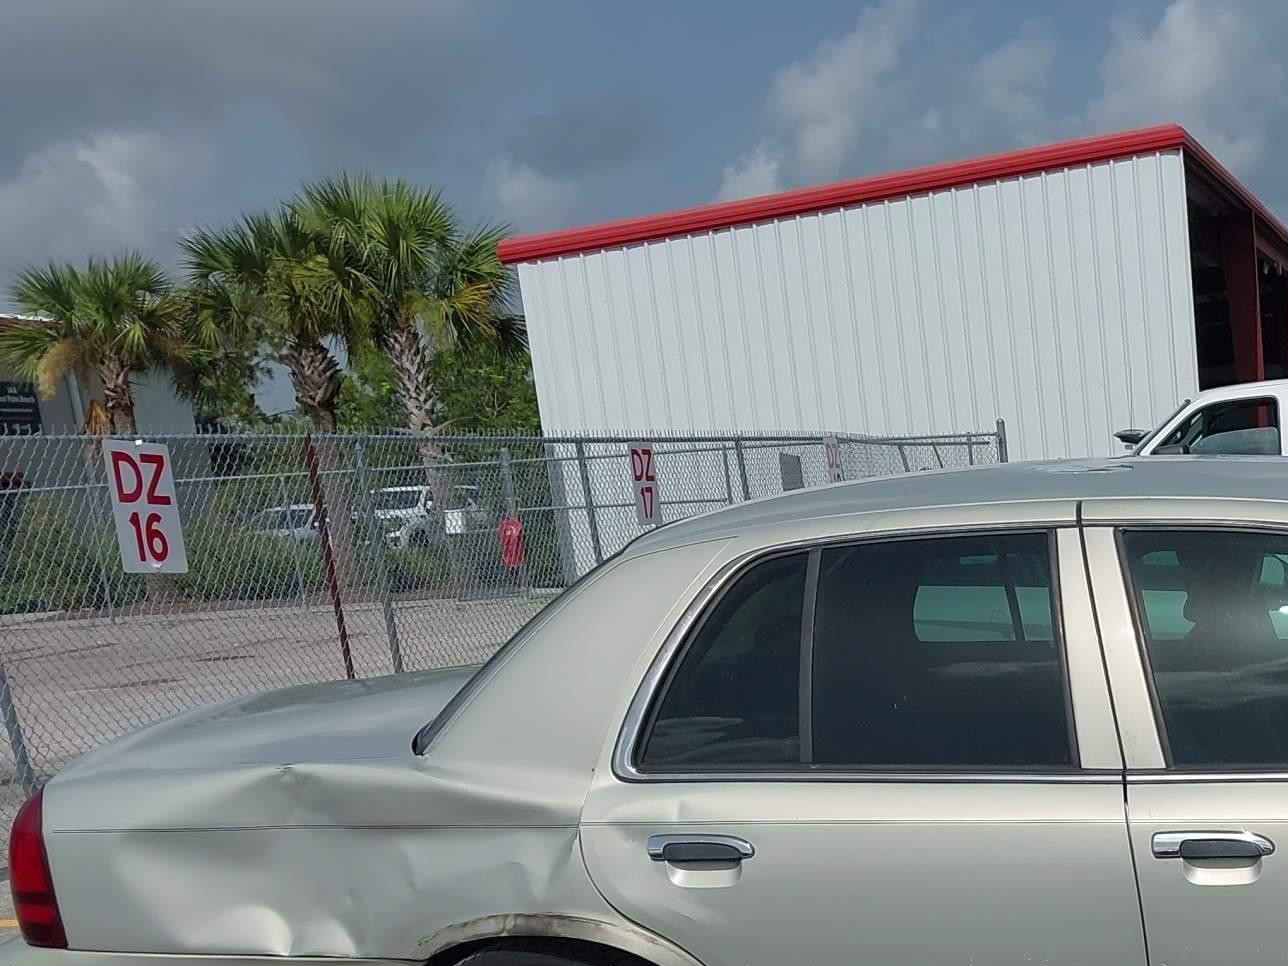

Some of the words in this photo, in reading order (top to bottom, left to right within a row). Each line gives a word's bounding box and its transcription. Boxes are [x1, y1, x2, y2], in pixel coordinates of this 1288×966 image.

[111, 451, 171, 505] DZ
[631, 449, 655, 481] DZ
[640, 487, 653, 518] 17
[129, 512, 168, 562] 16
